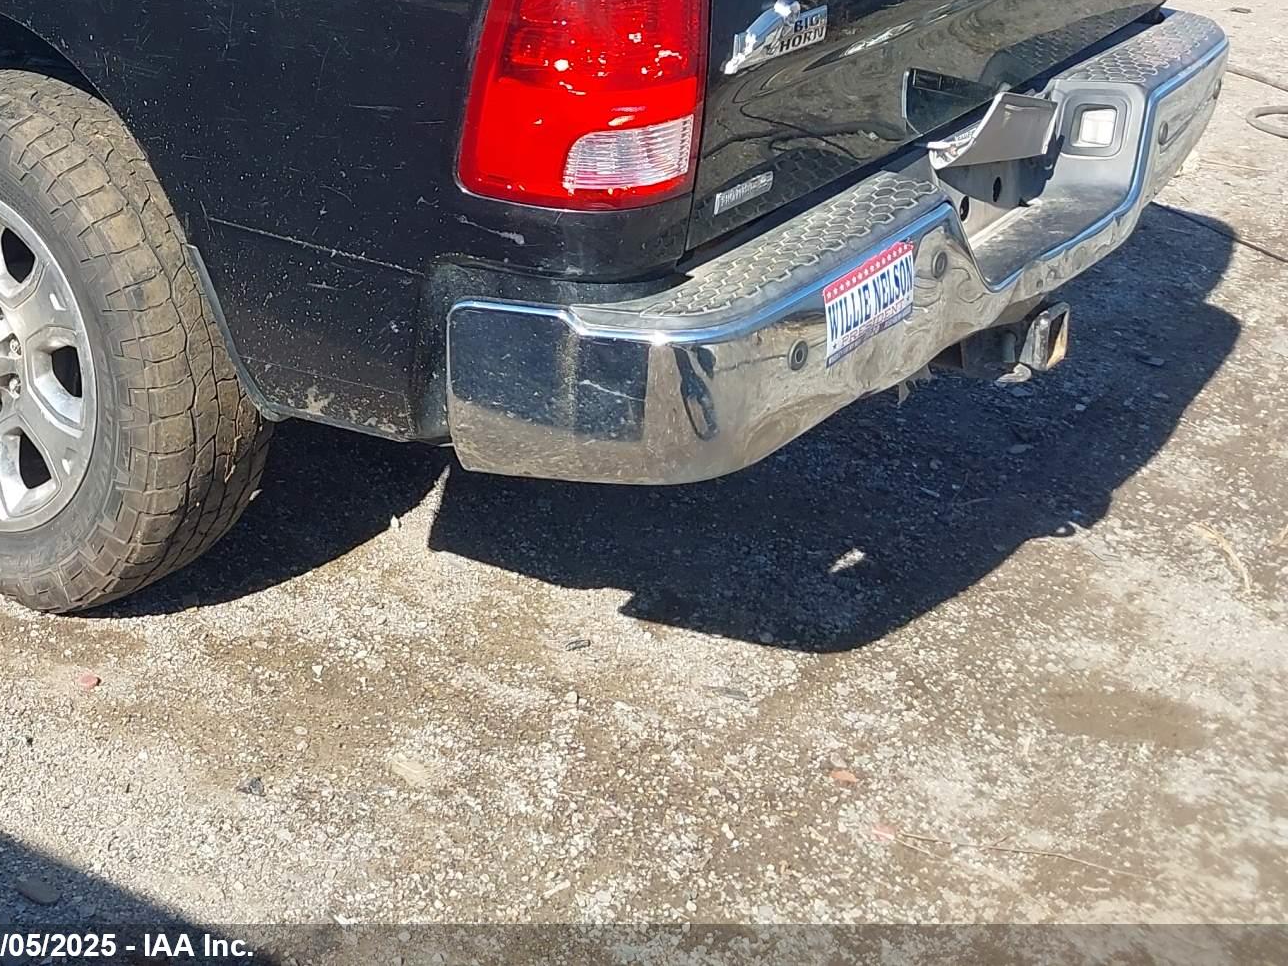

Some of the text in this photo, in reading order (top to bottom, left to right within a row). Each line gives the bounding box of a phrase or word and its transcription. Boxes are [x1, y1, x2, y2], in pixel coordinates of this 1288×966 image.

[793, 13, 822, 33] BIG
[779, 26, 825, 52] HORN
[827, 283, 871, 342] WILLIE
[872, 254, 913, 316] NELSON
